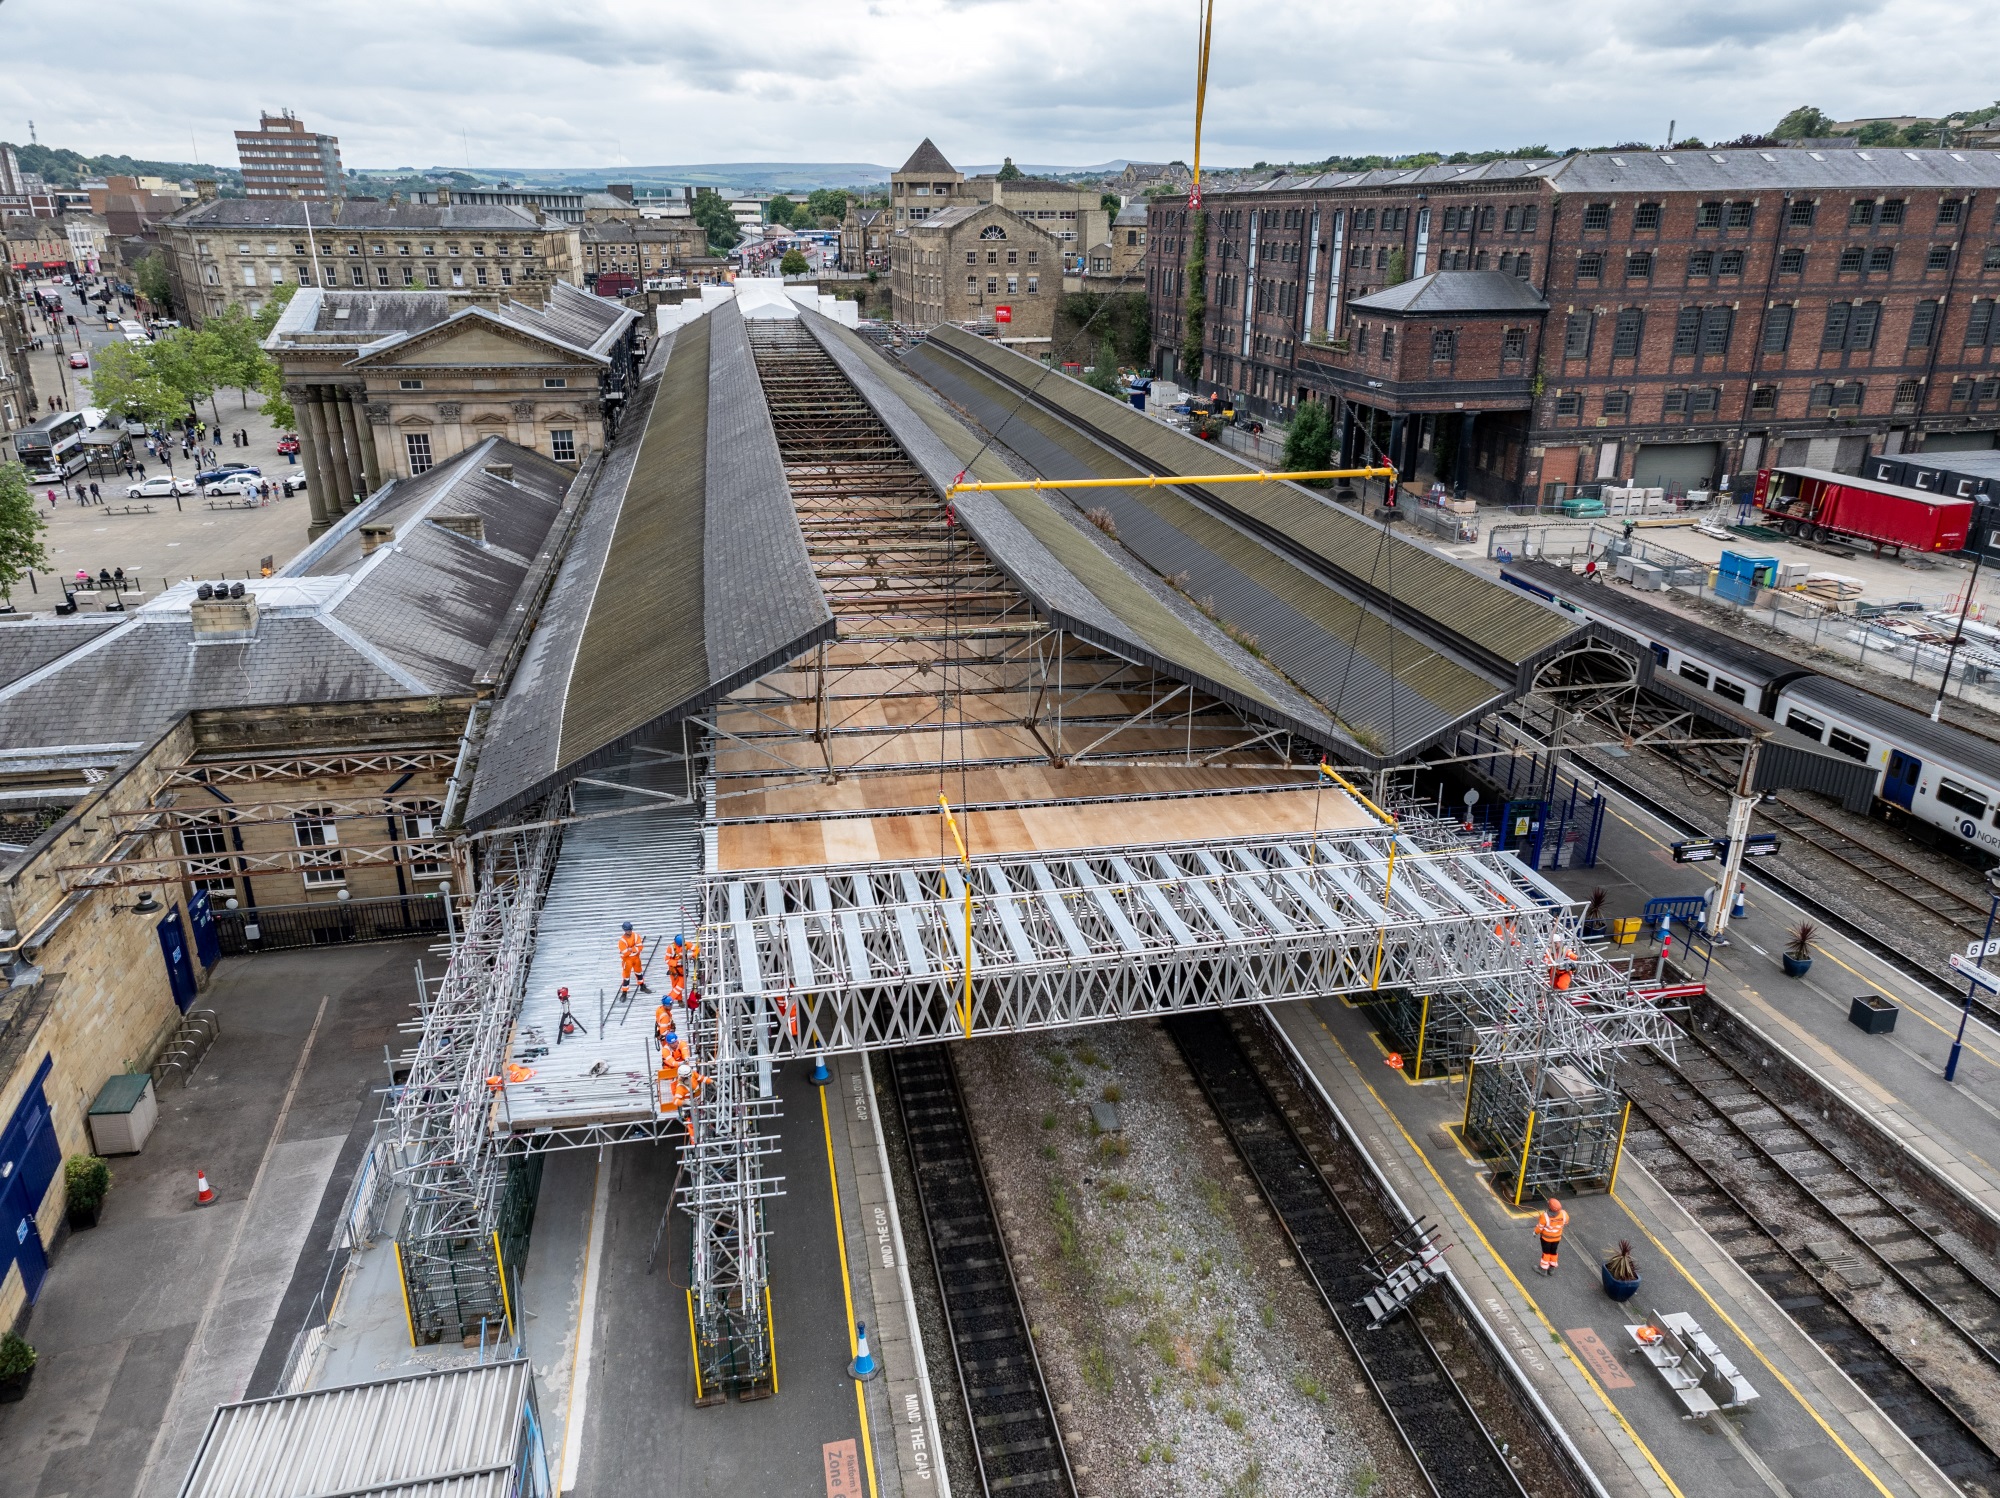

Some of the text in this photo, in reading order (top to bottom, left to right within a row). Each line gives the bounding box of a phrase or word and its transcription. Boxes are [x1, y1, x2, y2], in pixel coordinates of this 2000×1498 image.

[1970, 944, 1979, 955] 6
[1988, 942, 1997, 953] 8
[855, 1093, 866, 1105] THE
[856, 1106, 868, 1120] GAP
[874, 1207, 895, 1269] MIND THE GAP
[1484, 1298, 1545, 1371] MIND THE GAP
[1581, 1346, 1607, 1375] Platform
[1584, 1335, 1626, 1379] Zone 6
[905, 1393, 931, 1480] MIND THE GAP
[828, 1450, 843, 1487] Zone
[846, 1454, 856, 1488] Platform
